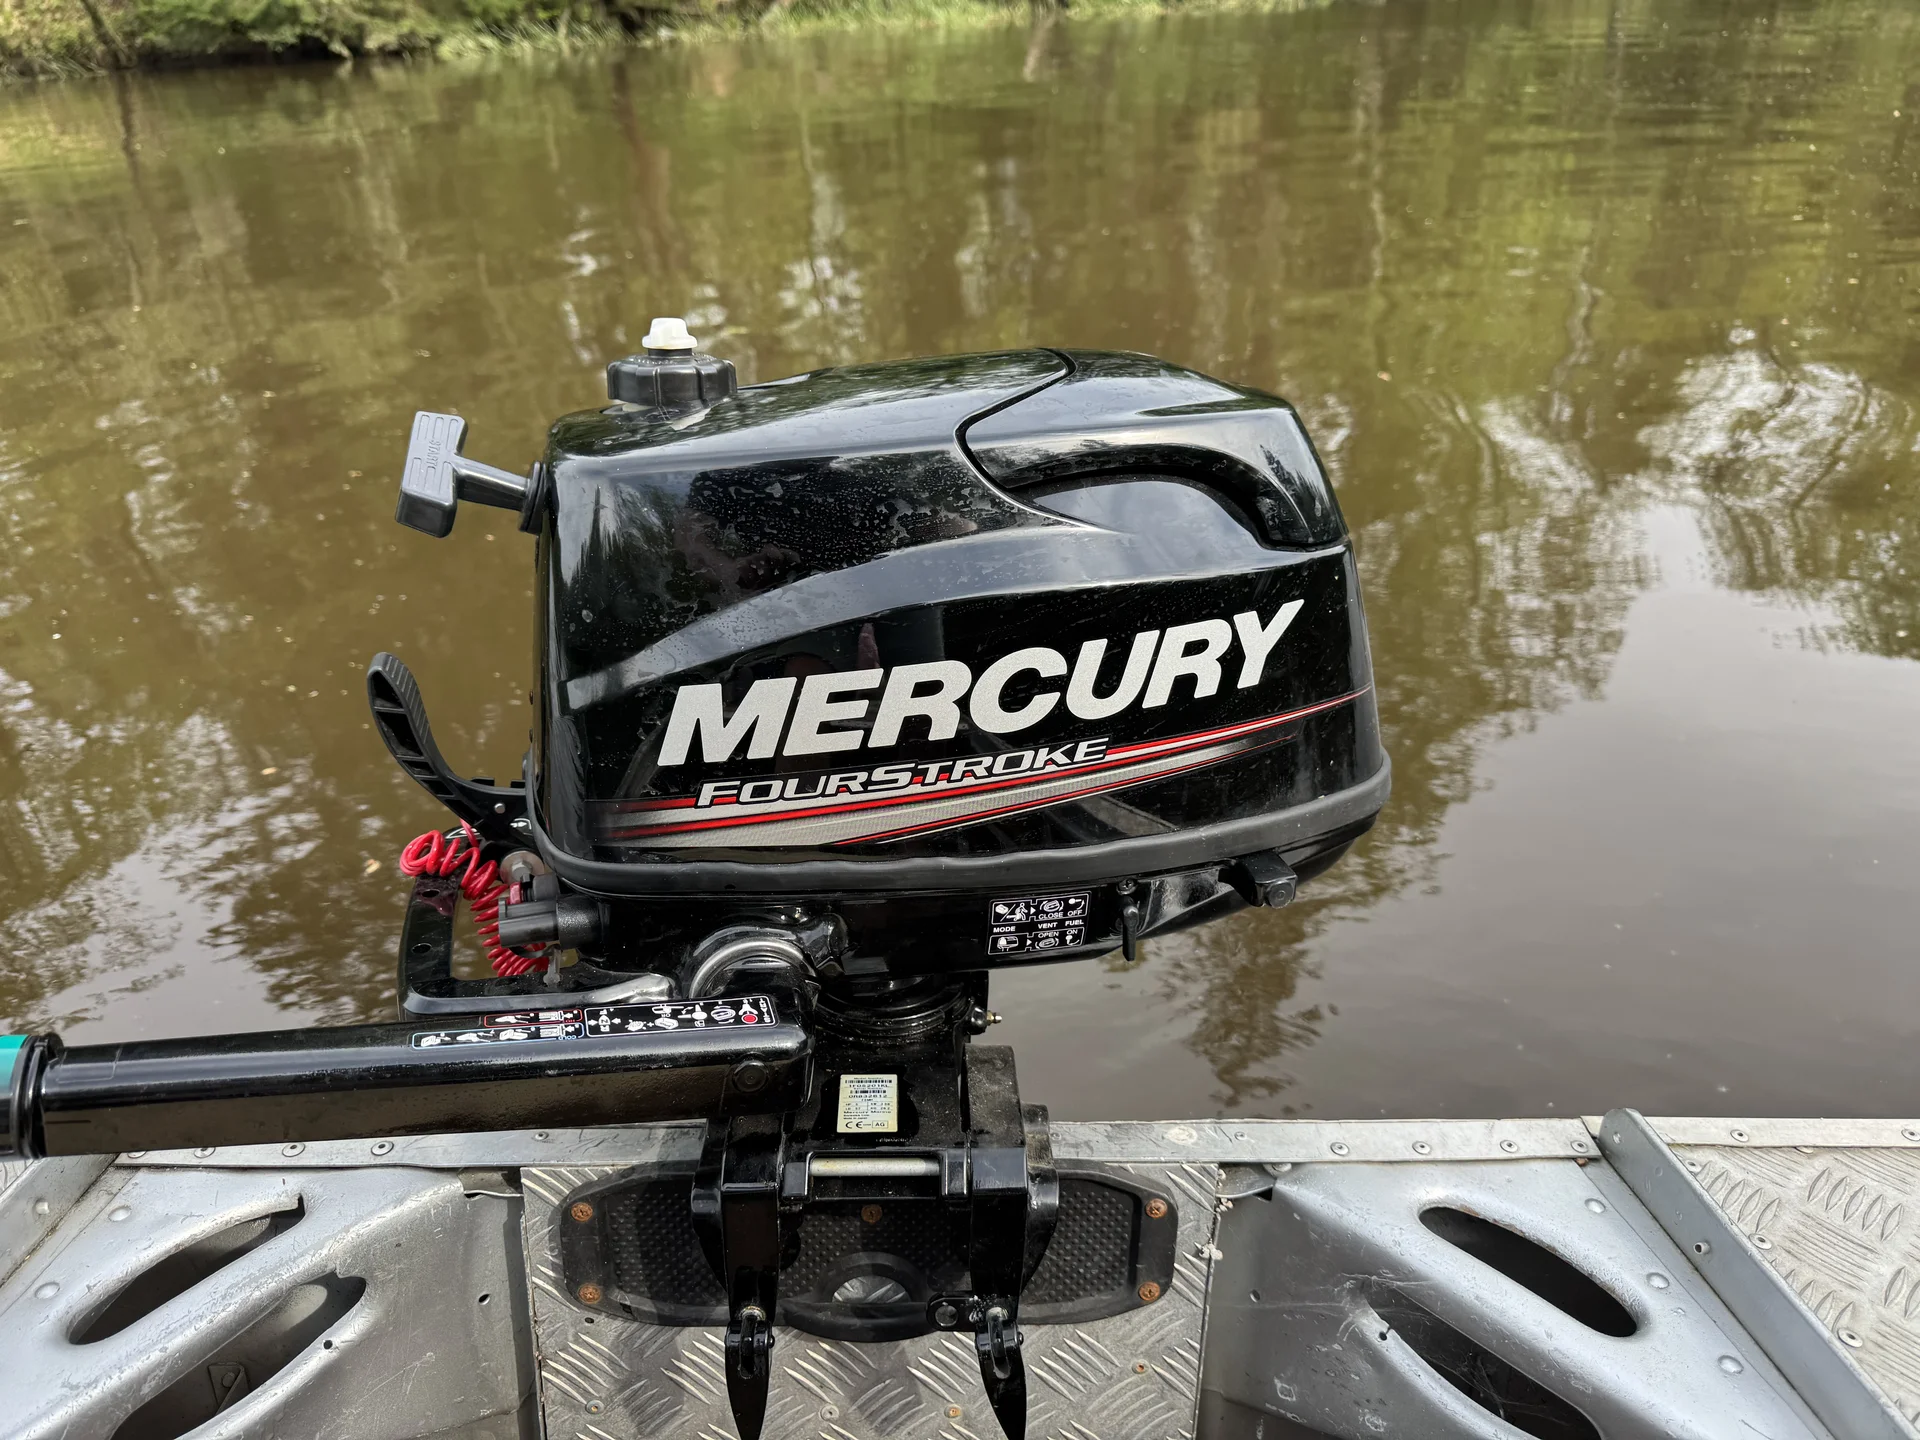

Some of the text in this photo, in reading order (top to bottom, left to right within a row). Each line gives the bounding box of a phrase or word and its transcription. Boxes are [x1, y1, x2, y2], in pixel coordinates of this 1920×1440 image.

[657, 599, 1304, 767] MERCURY
[697, 737, 1110, 808] FOURSTROKE
[1038, 912, 1064, 920] CLOSE
[1065, 919, 1084, 927] FUEL
